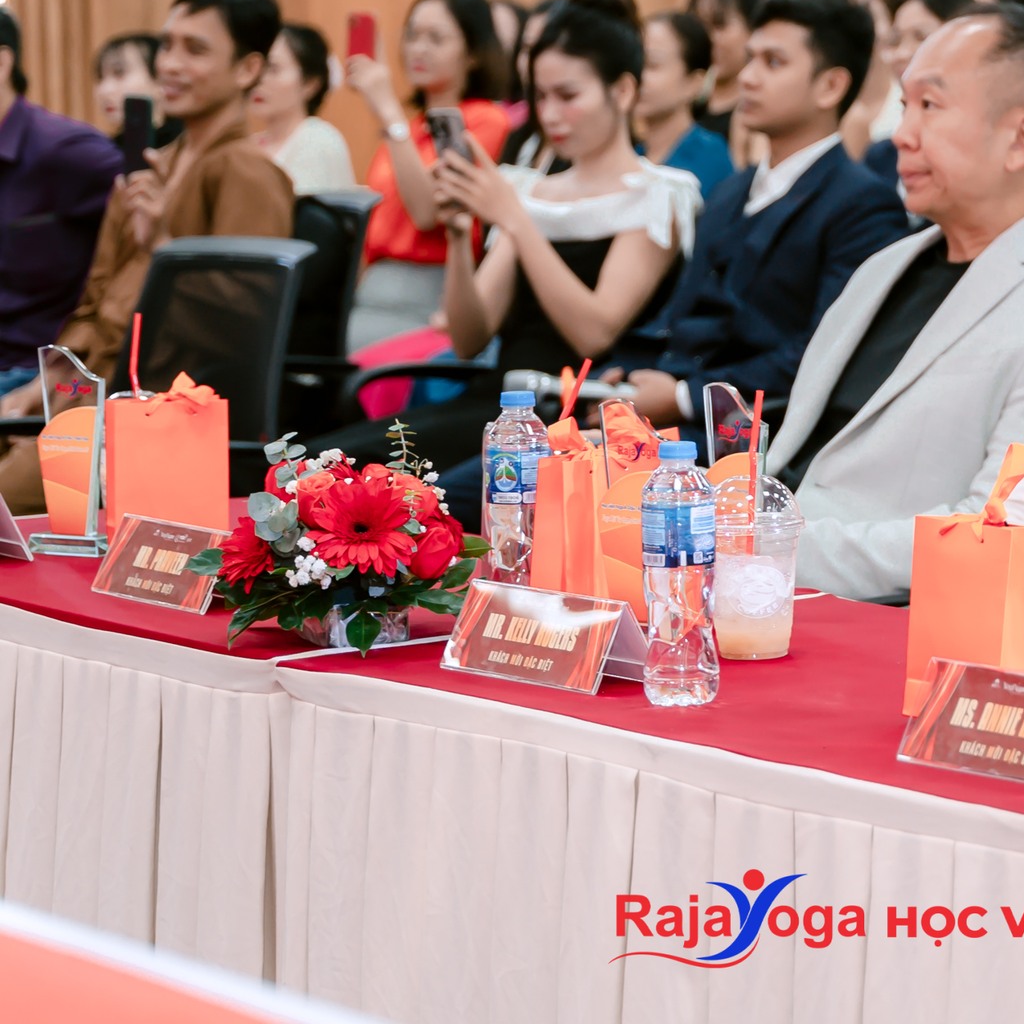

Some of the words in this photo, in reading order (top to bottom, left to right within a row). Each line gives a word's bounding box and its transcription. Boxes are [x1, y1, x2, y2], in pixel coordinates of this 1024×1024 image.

[482, 612, 507, 640] MR.
[505, 616, 541, 645] KELLY
[488, 650, 509, 663] KHÁCH
[537, 658, 554, 672] BIỆT
[949, 697, 979, 729] MS.
[959, 740, 986, 757] KHÁCH
